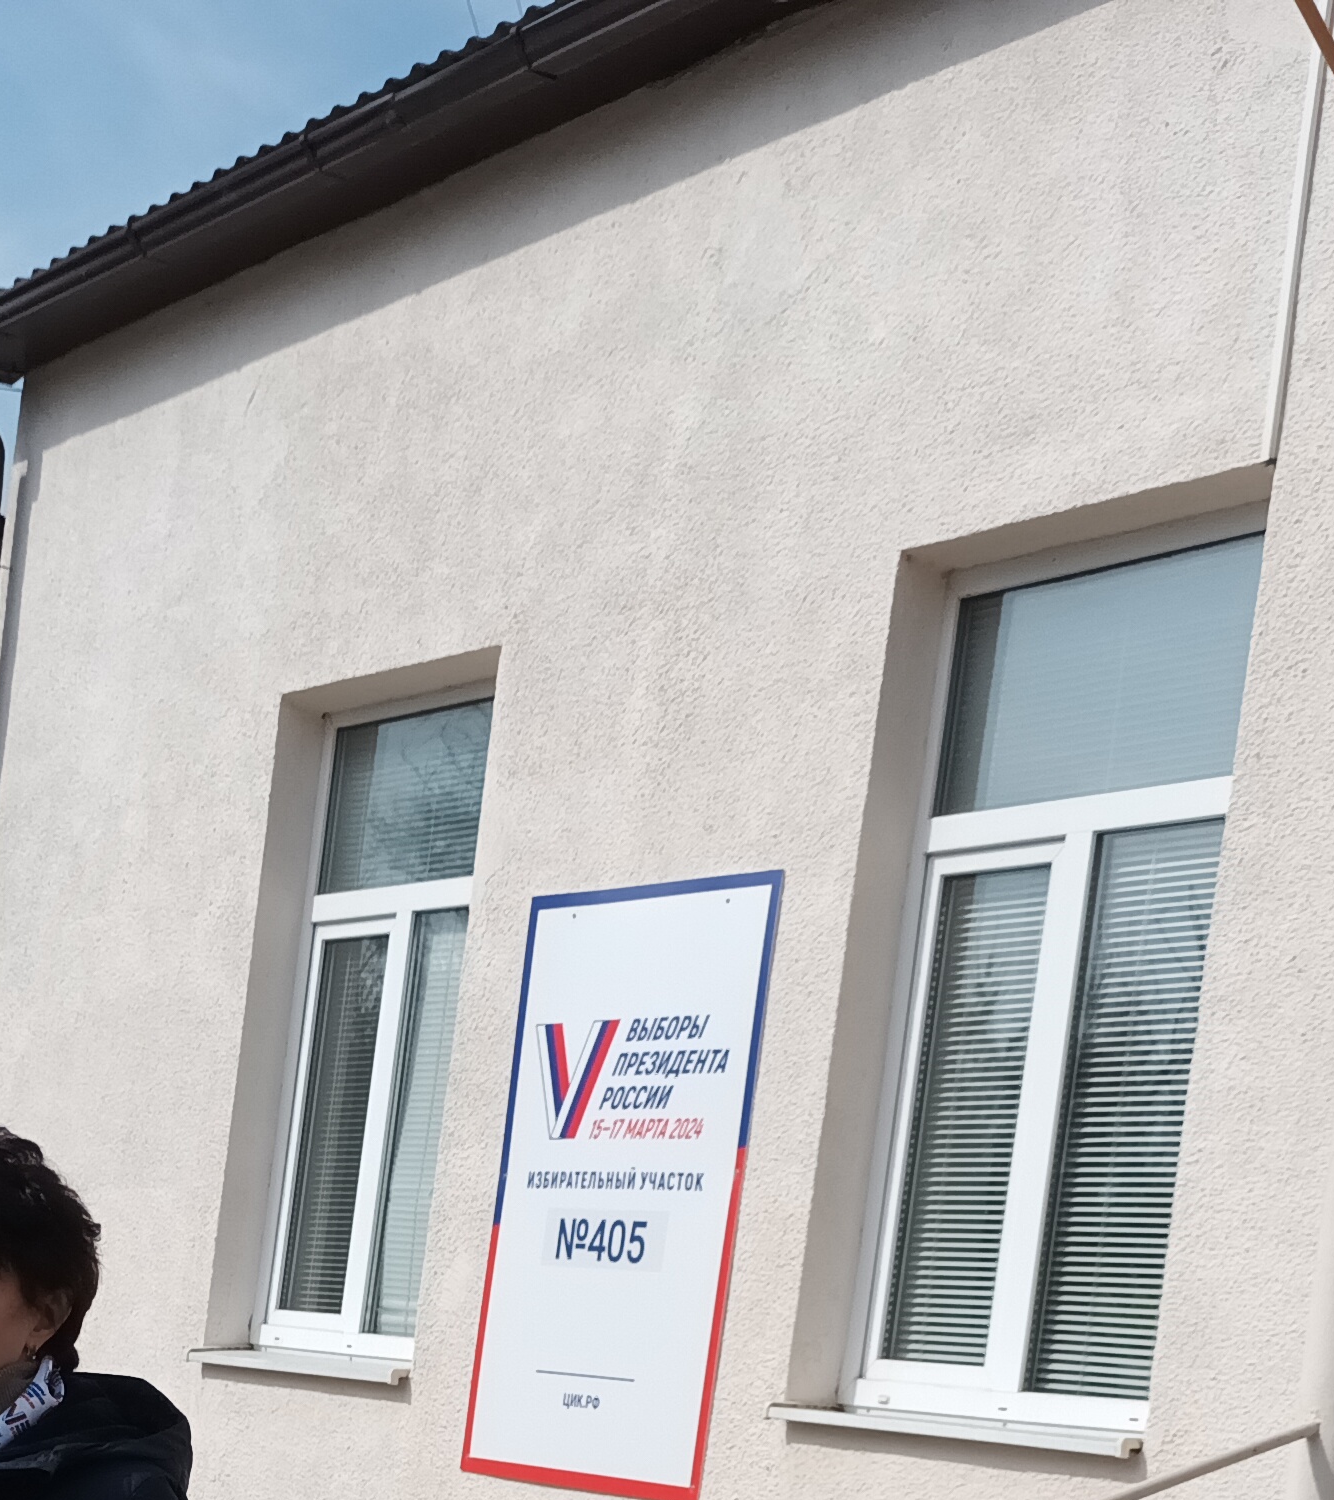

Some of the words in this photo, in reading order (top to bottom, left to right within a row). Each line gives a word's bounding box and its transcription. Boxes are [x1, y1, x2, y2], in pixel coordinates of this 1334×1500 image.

[625, 1014, 710, 1042] ВЫБОРЫ
[612, 1048, 730, 1079] ПРЕЗИДЕНТА
[599, 1085, 674, 1110] РОССИИ
[623, 1118, 669, 1140] МАРТА
[668, 1118, 704, 1140] 2024
[527, 1167, 636, 1190] ИЗБИРАТЕЛЬНЫЙ
[639, 1172, 704, 1192] УЧАСТОК
[555, 1217, 648, 1264] №405
[563, 1392, 601, 1410] ЦИК.РФ
